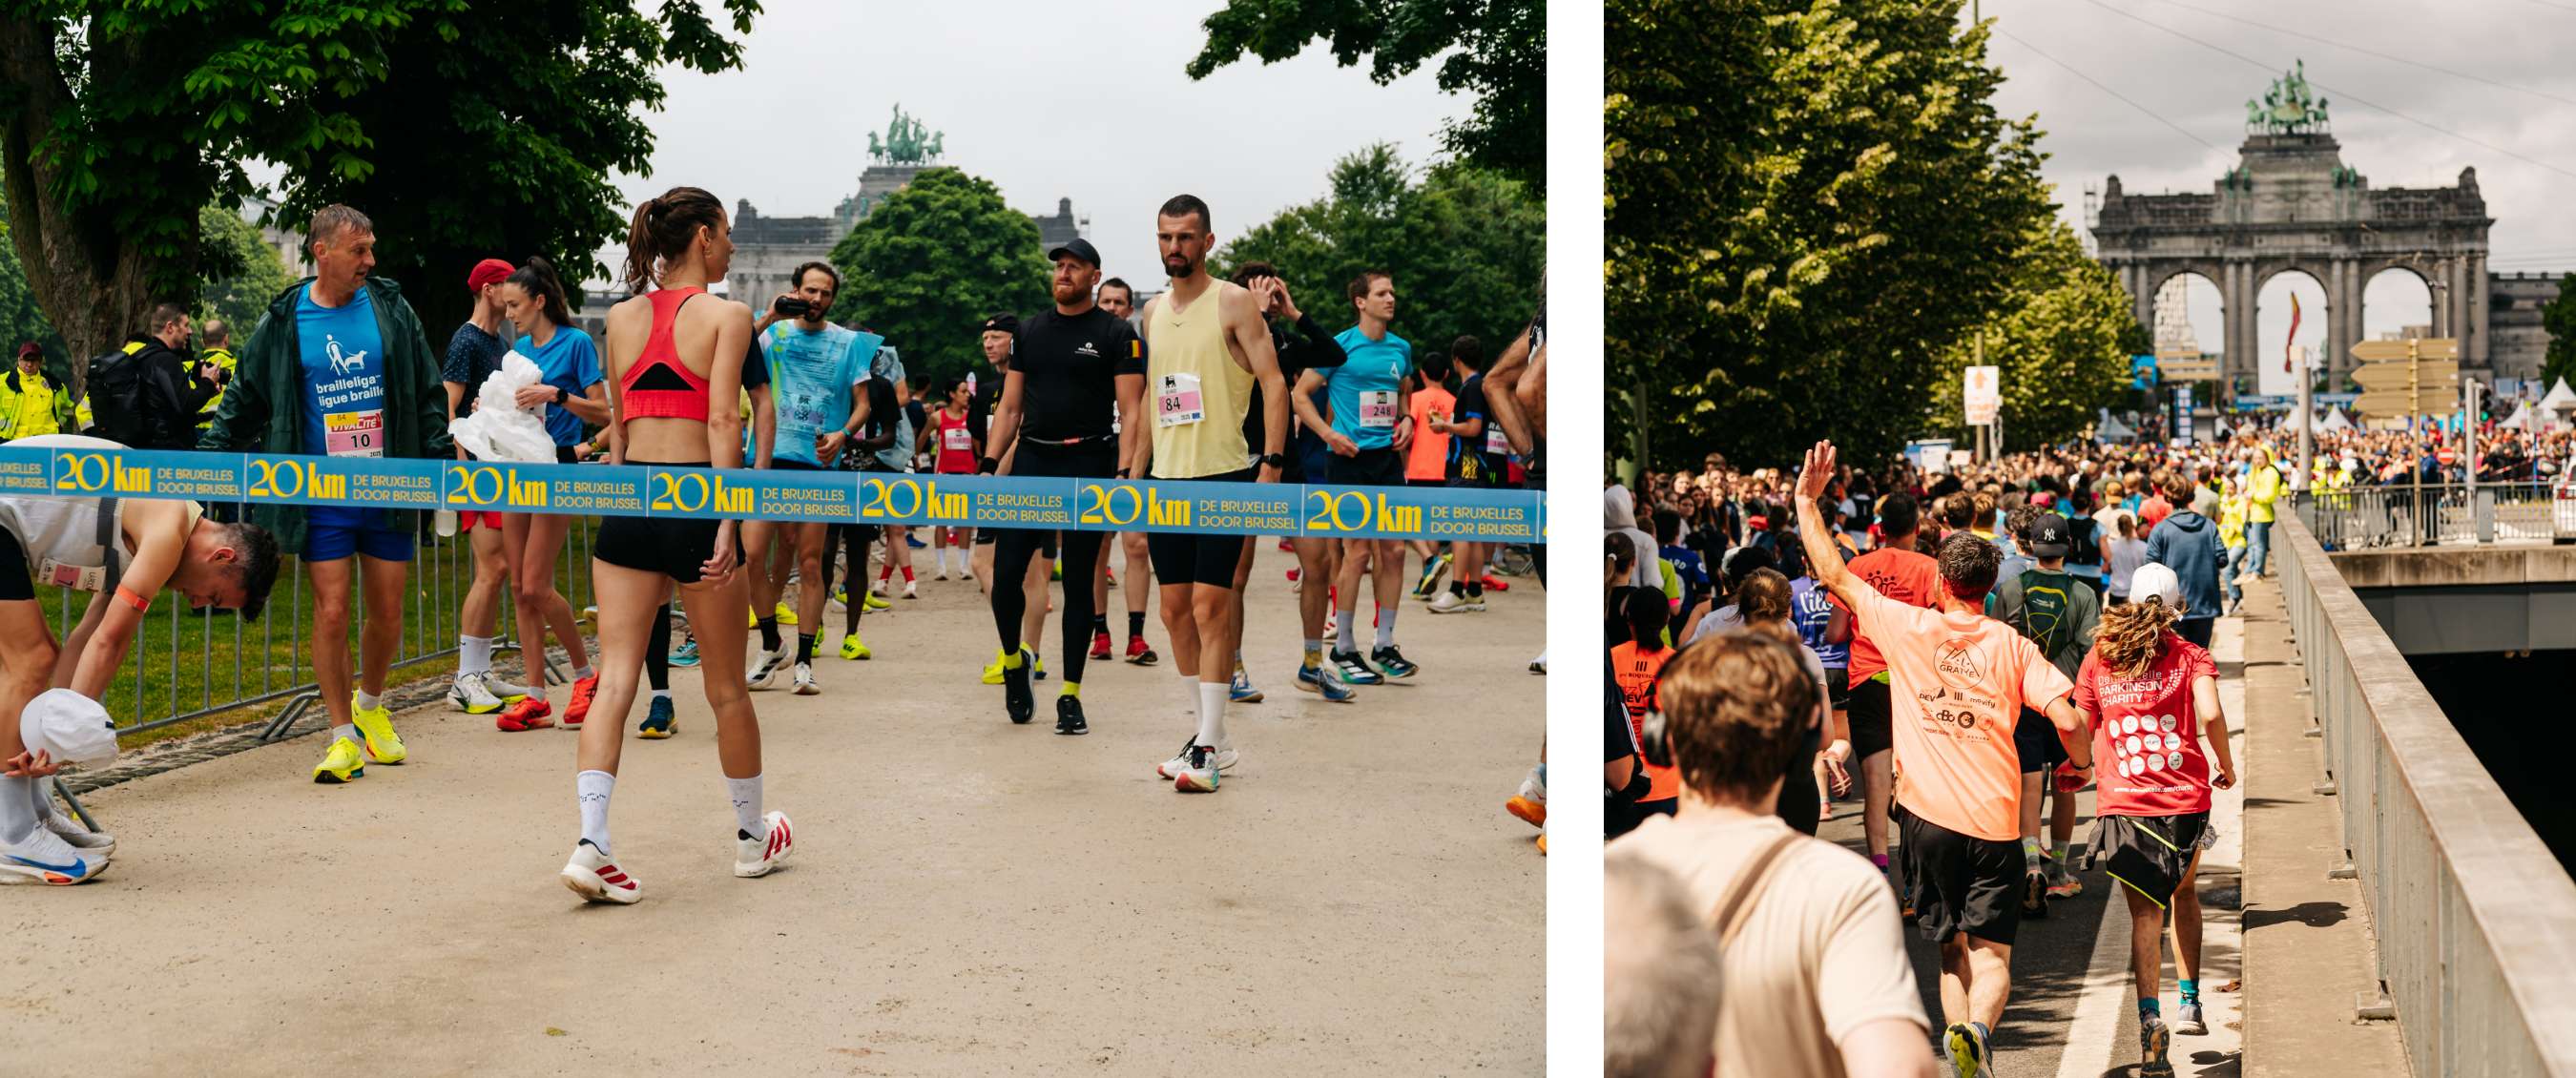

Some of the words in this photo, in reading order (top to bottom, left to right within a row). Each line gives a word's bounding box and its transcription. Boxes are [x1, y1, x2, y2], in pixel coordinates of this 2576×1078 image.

[316, 375, 376, 393] brailleliga
[318, 394, 348, 408] ligue
[1166, 397, 1180, 411] 84
[1374, 406, 1391, 416] 248
[351, 433, 371, 448] 10
[0, 463, 43, 474] UXELLES
[56, 453, 110, 491] 20
[114, 456, 151, 492] km
[157, 467, 173, 479] DE
[176, 468, 234, 481] BRUXELLES
[6, 476, 49, 488] BRUSSEL
[249, 460, 303, 498] 20
[308, 462, 345, 500] km
[353, 474, 368, 486] DE
[372, 475, 431, 488] BRUXELLES
[447, 466, 503, 505] 20
[509, 468, 547, 507] km
[157, 482, 194, 493] DOOR
[197, 484, 240, 496] BRUSSEL
[554, 481, 571, 493] DE
[573, 482, 634, 495] BRUXELLES
[652, 472, 709, 511] 20
[715, 475, 754, 513] km
[762, 487, 779, 500] DE
[782, 488, 844, 502] BRUXELLES
[353, 488, 389, 501] DOOR
[393, 490, 438, 504] BRUSSEL
[554, 496, 592, 508] DOOR
[595, 497, 642, 510] BRUSSEL
[862, 478, 922, 518] 20
[927, 480, 968, 520] km
[977, 493, 993, 506] DE
[997, 494, 1062, 508] BRUXELLES
[762, 503, 801, 515] DOOR
[804, 504, 854, 517] BRUSSEL
[1080, 485, 1142, 525] 20
[1148, 487, 1191, 527] km
[1199, 500, 1217, 512] DE
[1220, 501, 1288, 514] BRUXELLES
[1307, 489, 1372, 531] 20
[1377, 492, 1422, 533] km
[1431, 506, 1449, 519] DE
[1453, 507, 1524, 520] BRUXELLES
[977, 508, 1017, 521] DOOR
[1020, 509, 1070, 523] BRUSSEL
[1199, 515, 1241, 528] DOOR
[1244, 516, 1298, 529] BRUSSEL
[1431, 522, 1475, 534] DOOR
[1478, 523, 1532, 536] BRUSSEL
[2099, 680, 2163, 697] PARKINSON
[1626, 694, 1642, 703] EV
[1919, 693, 1936, 702] DEV
[2102, 693, 2144, 708] CHARITY
